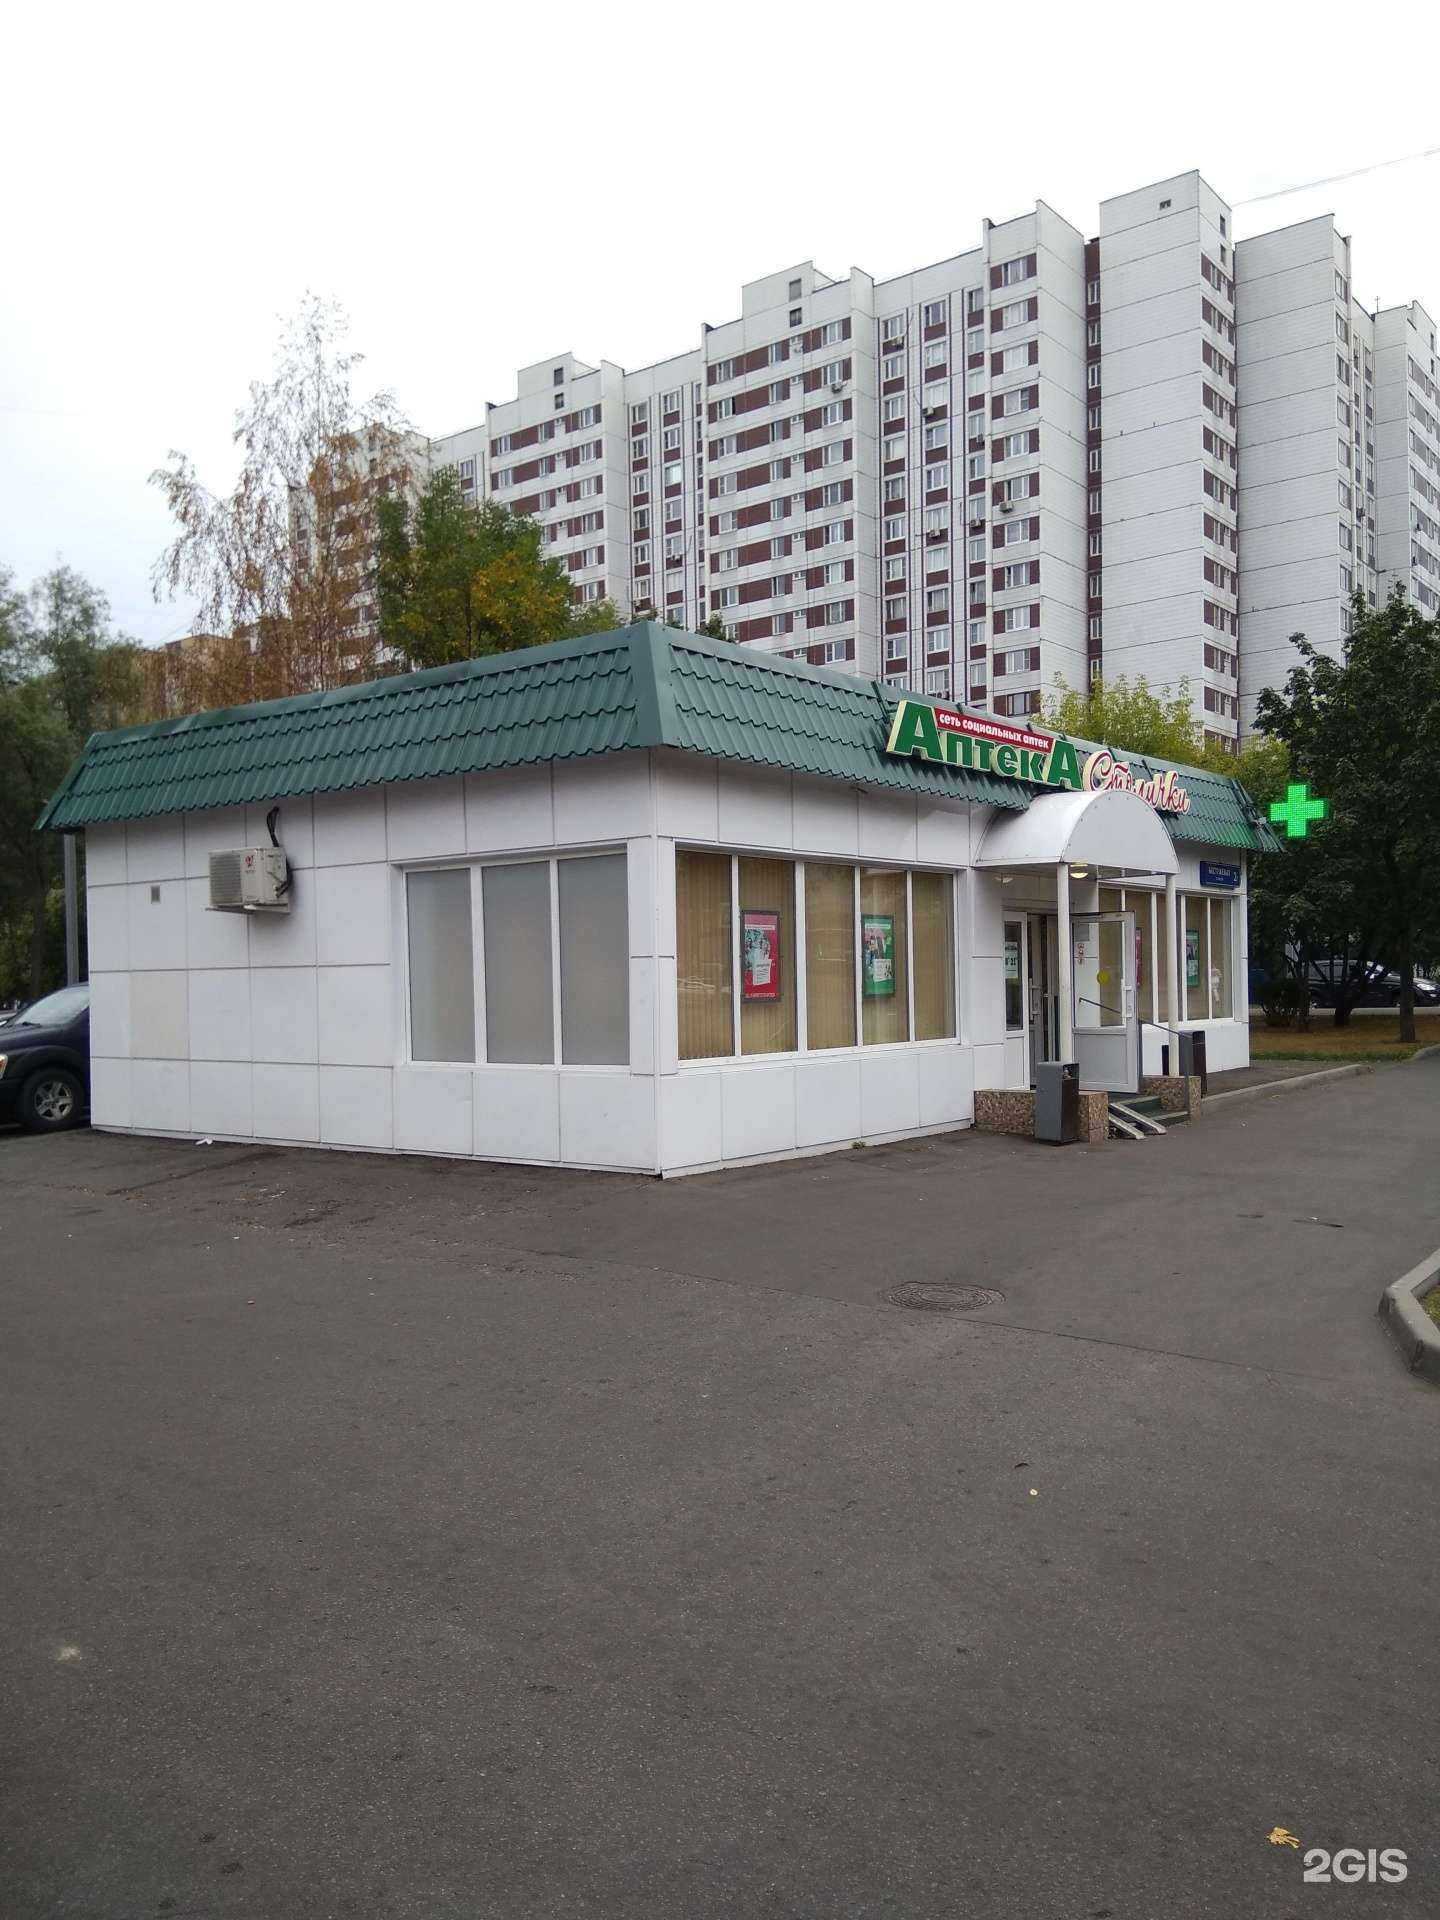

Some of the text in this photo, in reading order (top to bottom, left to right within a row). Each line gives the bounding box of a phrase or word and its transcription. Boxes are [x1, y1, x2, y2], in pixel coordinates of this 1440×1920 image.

[939, 713, 1049, 749] сеть социальных аптек
